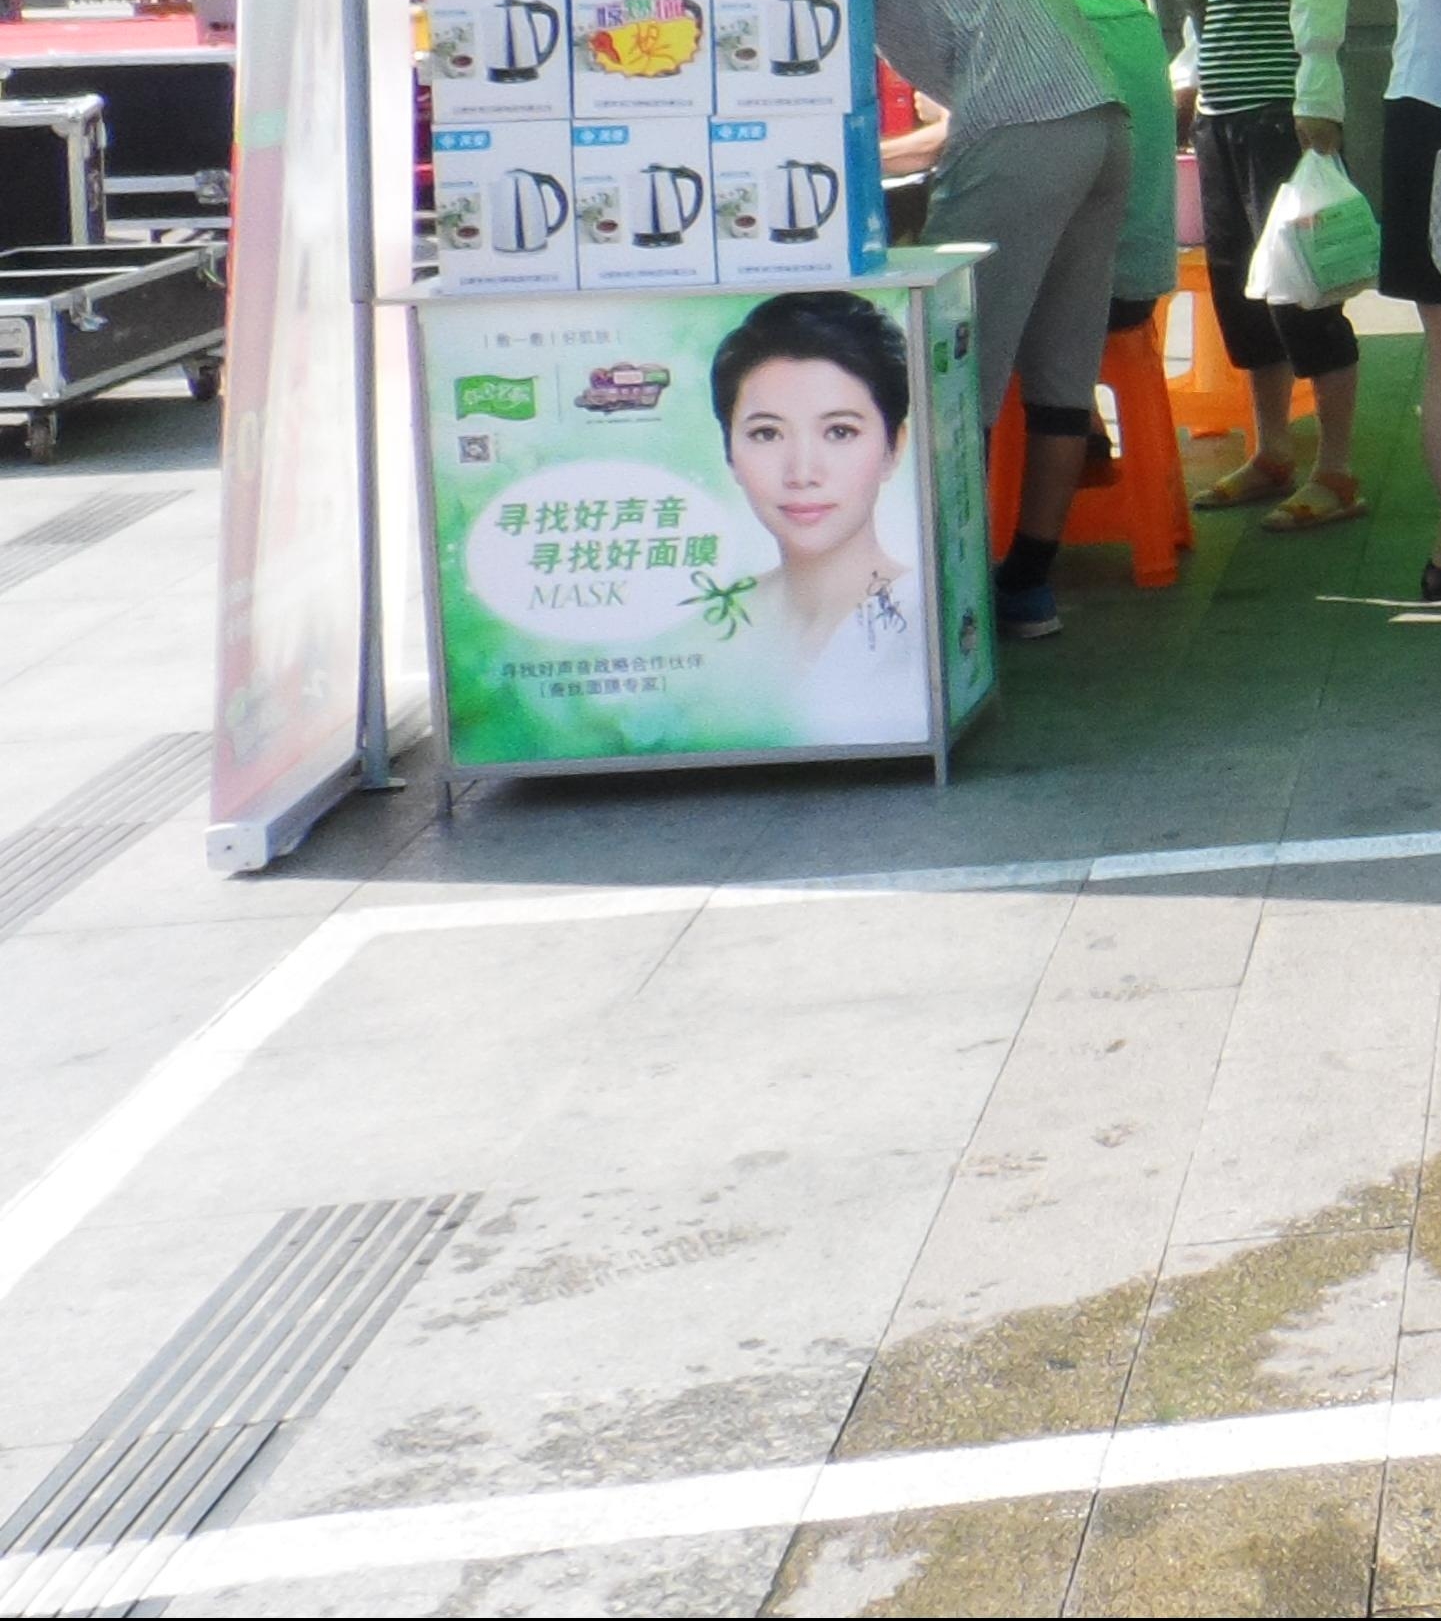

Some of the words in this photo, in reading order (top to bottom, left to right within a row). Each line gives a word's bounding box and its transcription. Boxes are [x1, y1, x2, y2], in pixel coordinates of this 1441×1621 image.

[494, 495, 688, 536] 寻找好声音
[529, 533, 719, 574] 寻找好面膜
[527, 579, 628, 611] MASK
